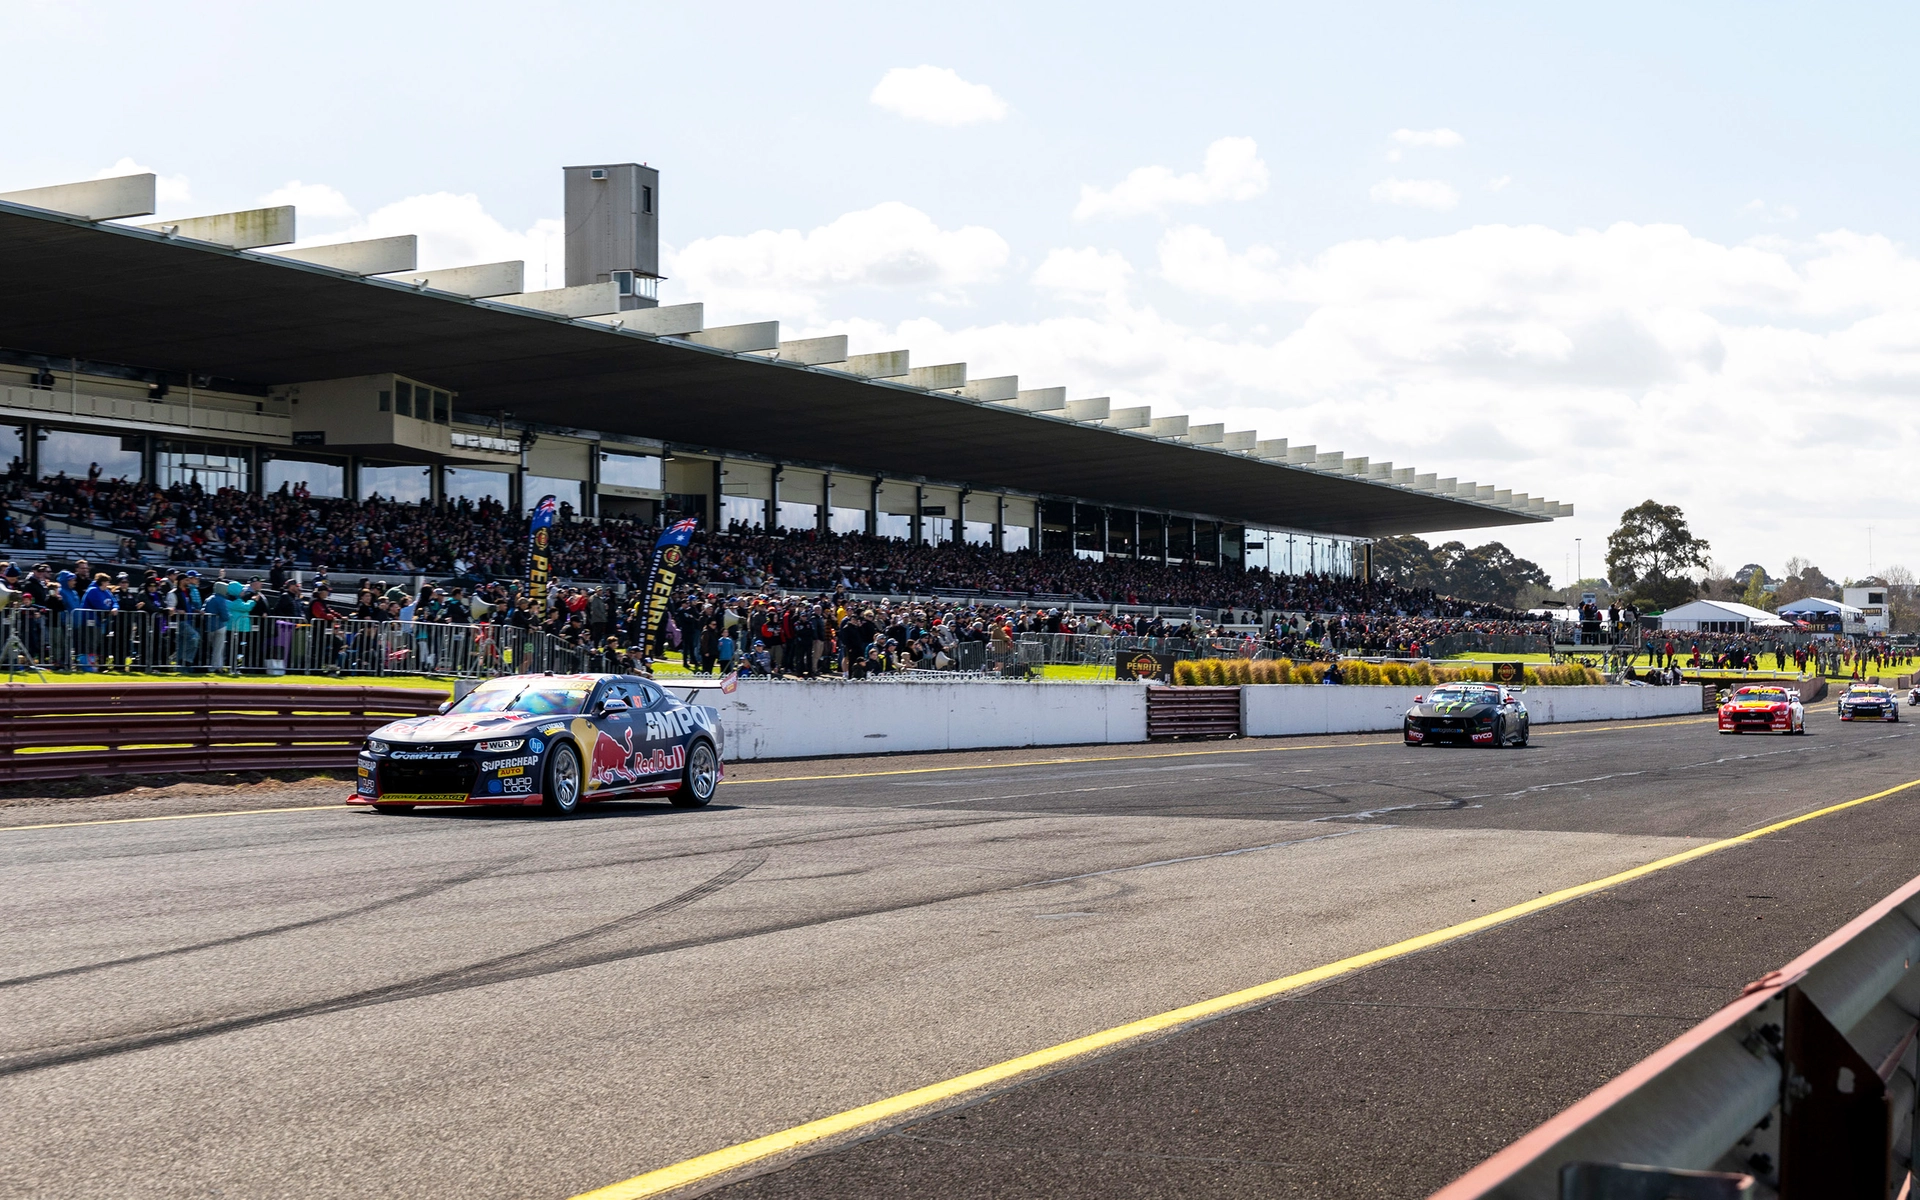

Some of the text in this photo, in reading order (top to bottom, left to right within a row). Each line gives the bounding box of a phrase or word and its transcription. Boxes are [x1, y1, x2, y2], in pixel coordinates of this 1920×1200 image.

[646, 549, 663, 591] AUSTRALIAN
[530, 554, 549, 620] PENR
[642, 594, 651, 613] MADE
[640, 616, 648, 629] AND
[1807, 623, 1826, 631] RITE
[1126, 661, 1162, 672] PENRITE
[645, 705, 717, 741] AMPOL
[1409, 730, 1424, 739] RYCO
[1472, 732, 1493, 741] RYCO
[532, 740, 542, 753] hp
[481, 755, 539, 772] SUPERCHEAP
[500, 767, 521, 776] AUTO
[503, 777, 533, 786] QUAD
[503, 785, 533, 793] LOCK
